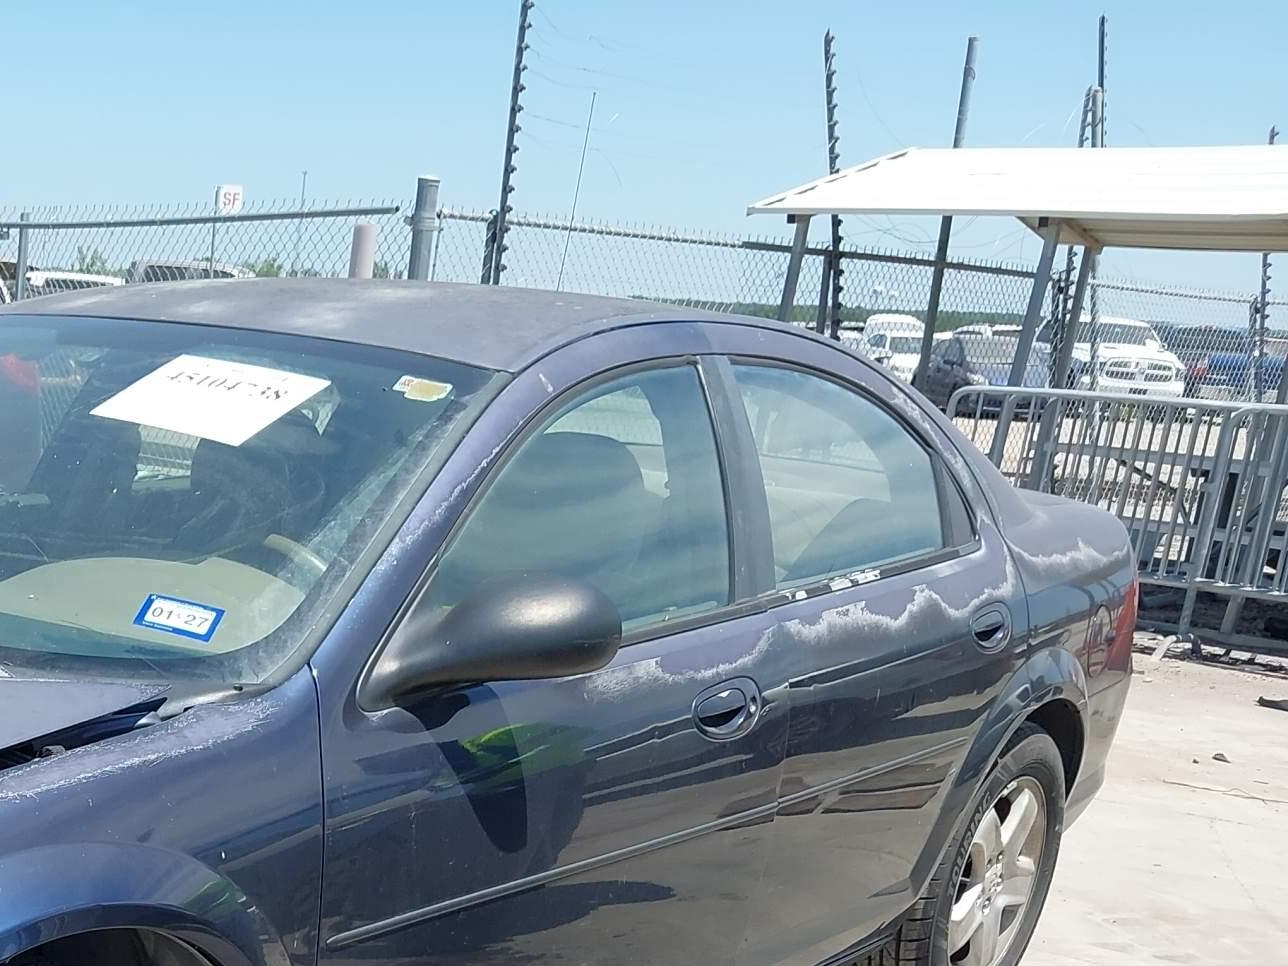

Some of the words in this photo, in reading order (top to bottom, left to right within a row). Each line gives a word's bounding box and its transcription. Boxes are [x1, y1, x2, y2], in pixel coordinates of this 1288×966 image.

[223, 192, 240, 208] SF
[152, 606, 173, 620] 01
[184, 614, 209, 627] 27
